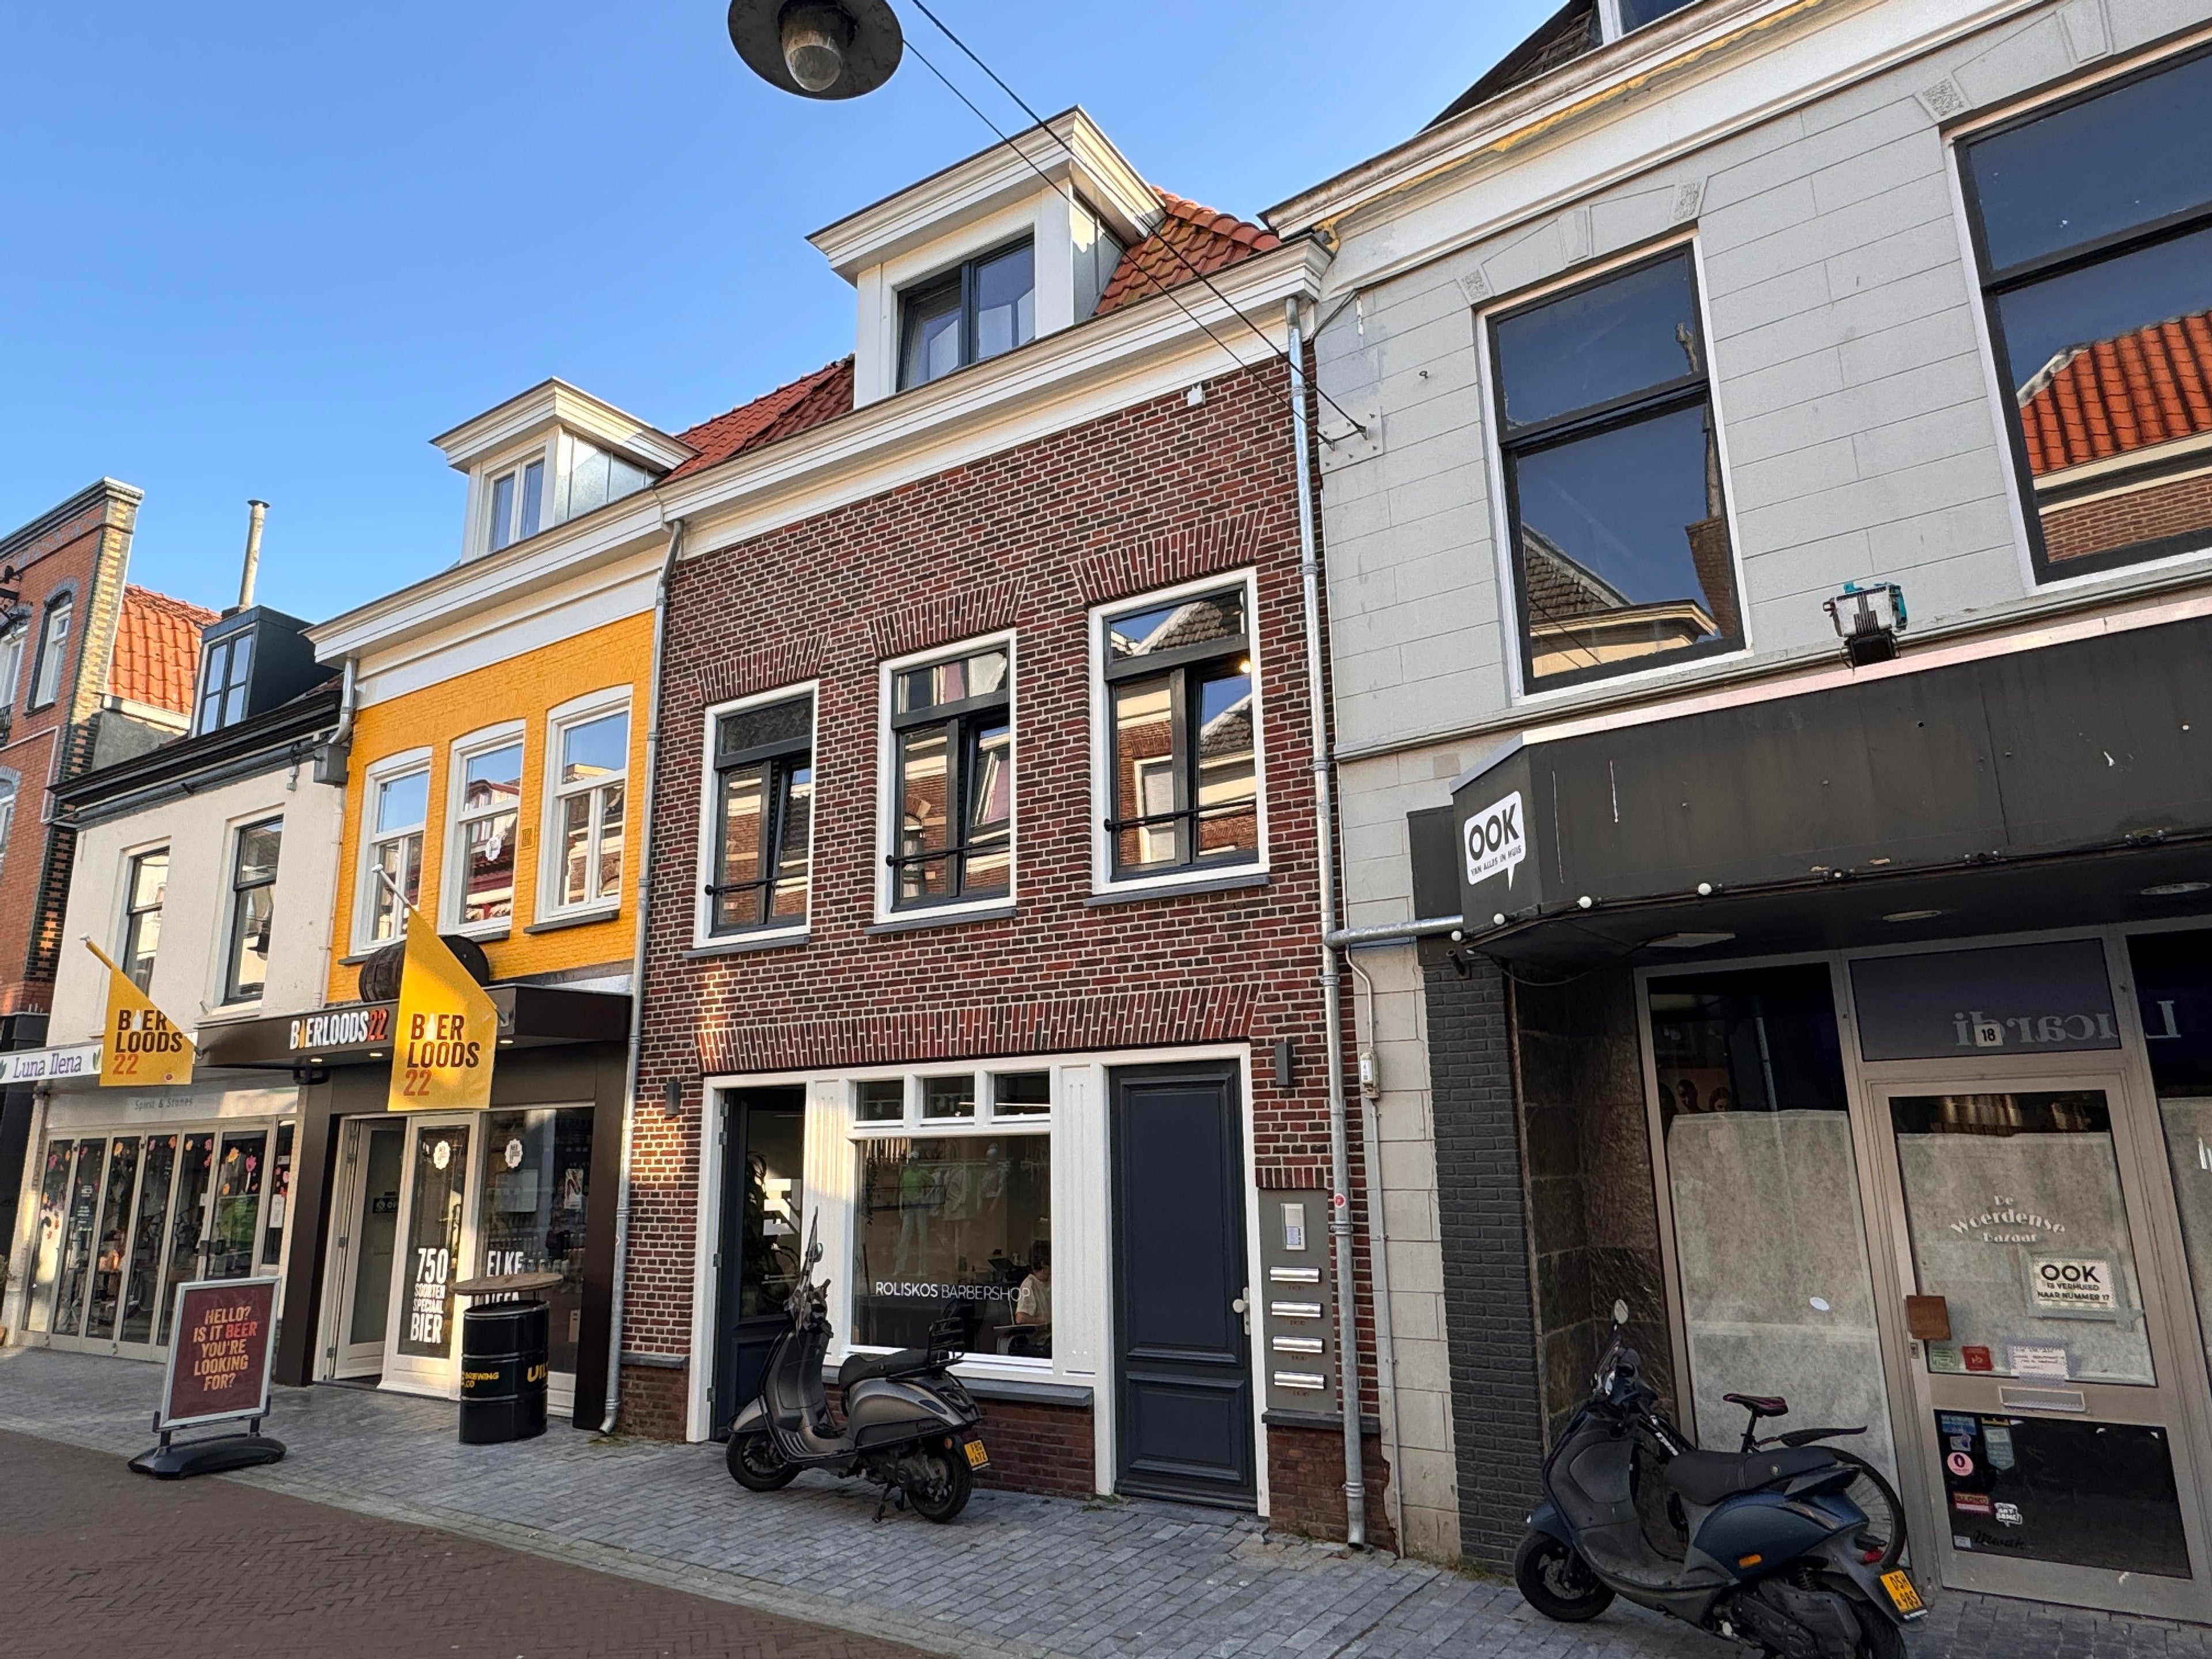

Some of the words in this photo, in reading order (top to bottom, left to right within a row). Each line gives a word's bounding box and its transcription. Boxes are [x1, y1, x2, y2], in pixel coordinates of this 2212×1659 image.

[1469, 802, 1519, 861] OOK
[411, 1013, 464, 1040] BIER
[1981, 1028, 1997, 1042] 18
[115, 1031, 183, 1053] LOODS
[112, 1054, 139, 1075] 22
[407, 1041, 480, 1068] LOODS
[13, 1056, 45, 1078] Luna
[404, 1069, 432, 1096] 22
[1994, 1195, 2014, 1206] De
[1950, 1209, 2066, 1234] Woerdense
[416, 1248, 449, 1284] 750
[2041, 1264, 2101, 1283] OOK
[415, 1283, 446, 1300] SOORTEN
[876, 1281, 938, 1298] ROLISKOS
[941, 1283, 1031, 1302] BARBERSHOP
[2062, 1293, 2100, 1301] NUMMER
[204, 1306, 251, 1325] HELLO?
[193, 1327, 207, 1343] IS
[210, 1324, 223, 1341] IT
[225, 1321, 258, 1339] BEER
[410, 1312, 443, 1344] BIER
[202, 1339, 247, 1358] YOU'RE
[194, 1354, 249, 1376] LOOKING
[203, 1372, 236, 1391] FOR?
